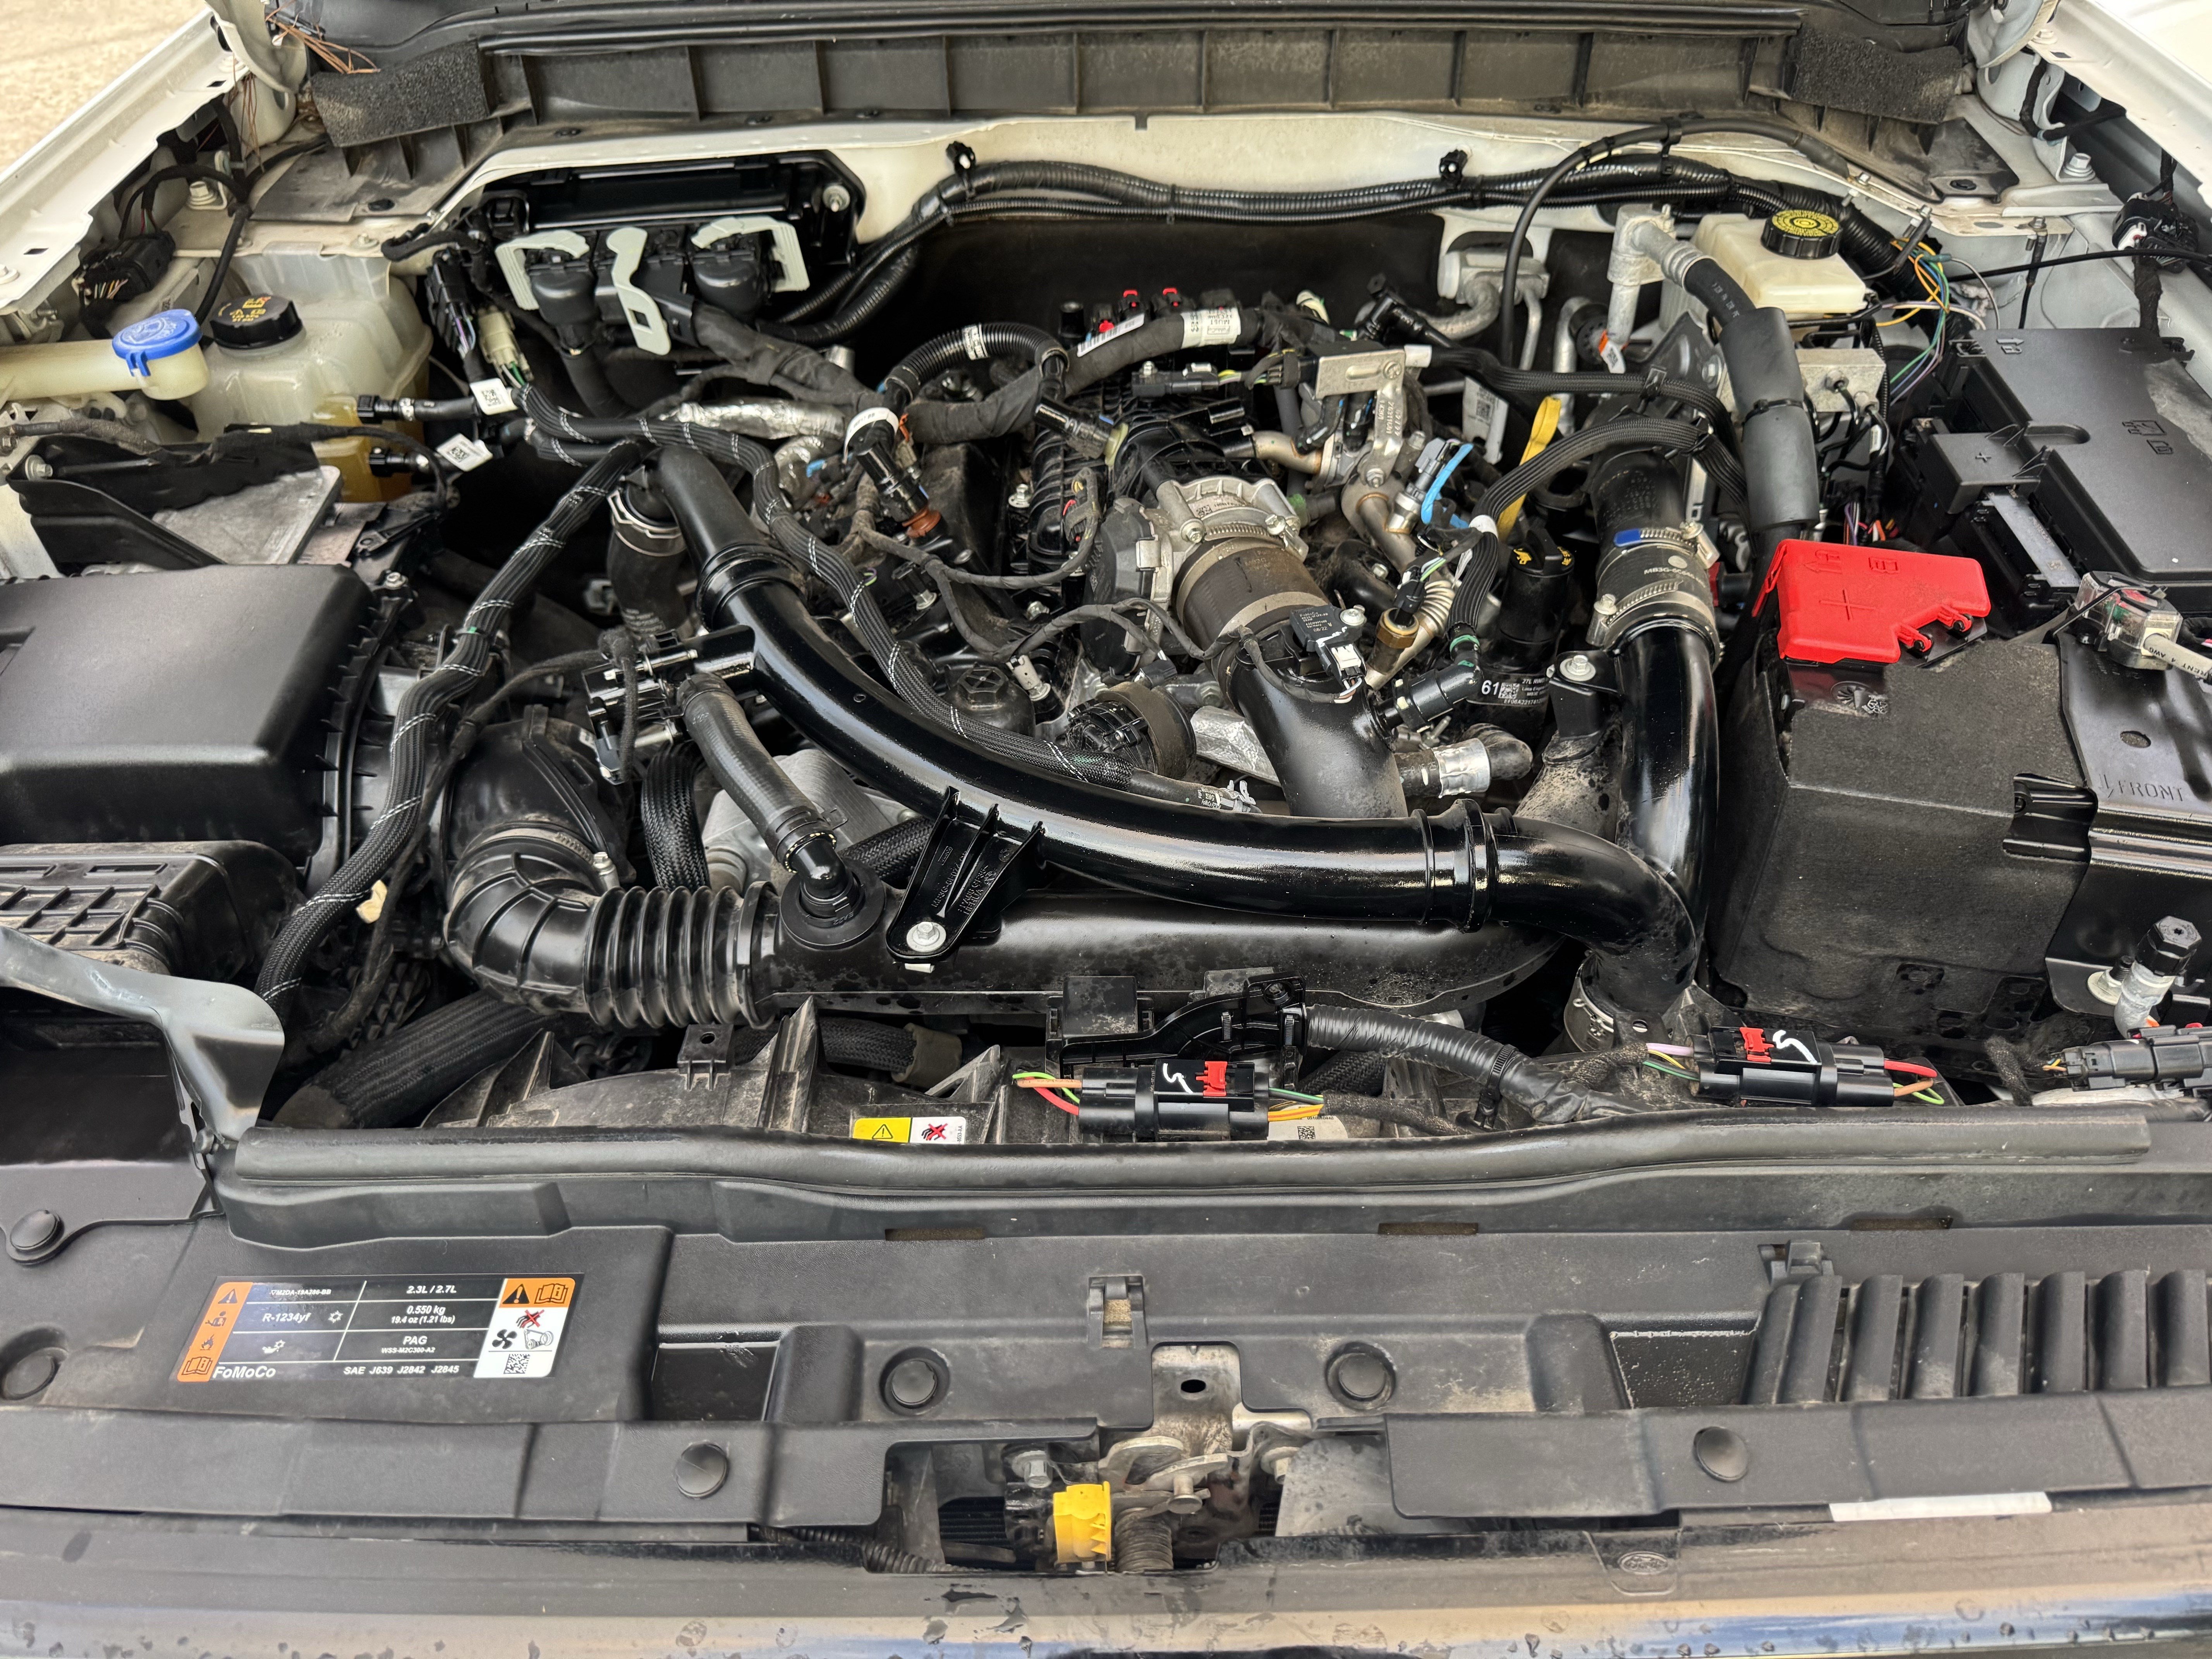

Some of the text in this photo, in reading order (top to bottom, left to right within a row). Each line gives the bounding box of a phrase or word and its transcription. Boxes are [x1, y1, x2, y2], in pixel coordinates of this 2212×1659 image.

[1481, 680, 1499, 695] 61
[2119, 780, 2183, 801] FRONT
[406, 1285, 428, 1294] 2.3L
[436, 1285, 457, 1294] 2.7L
[262, 1311, 311, 1323] R-1234yf
[406, 1305, 446, 1317] 0.550 kg
[391, 1315, 407, 1324] 19.4
[419, 1314, 438, 1325] (1.21
[440, 1314, 455, 1324] lbs)
[402, 1335, 428, 1346] PAG
[212, 1365, 276, 1379] FoMoCo
[343, 1365, 460, 1375] SAE J639 J2842 J2845
